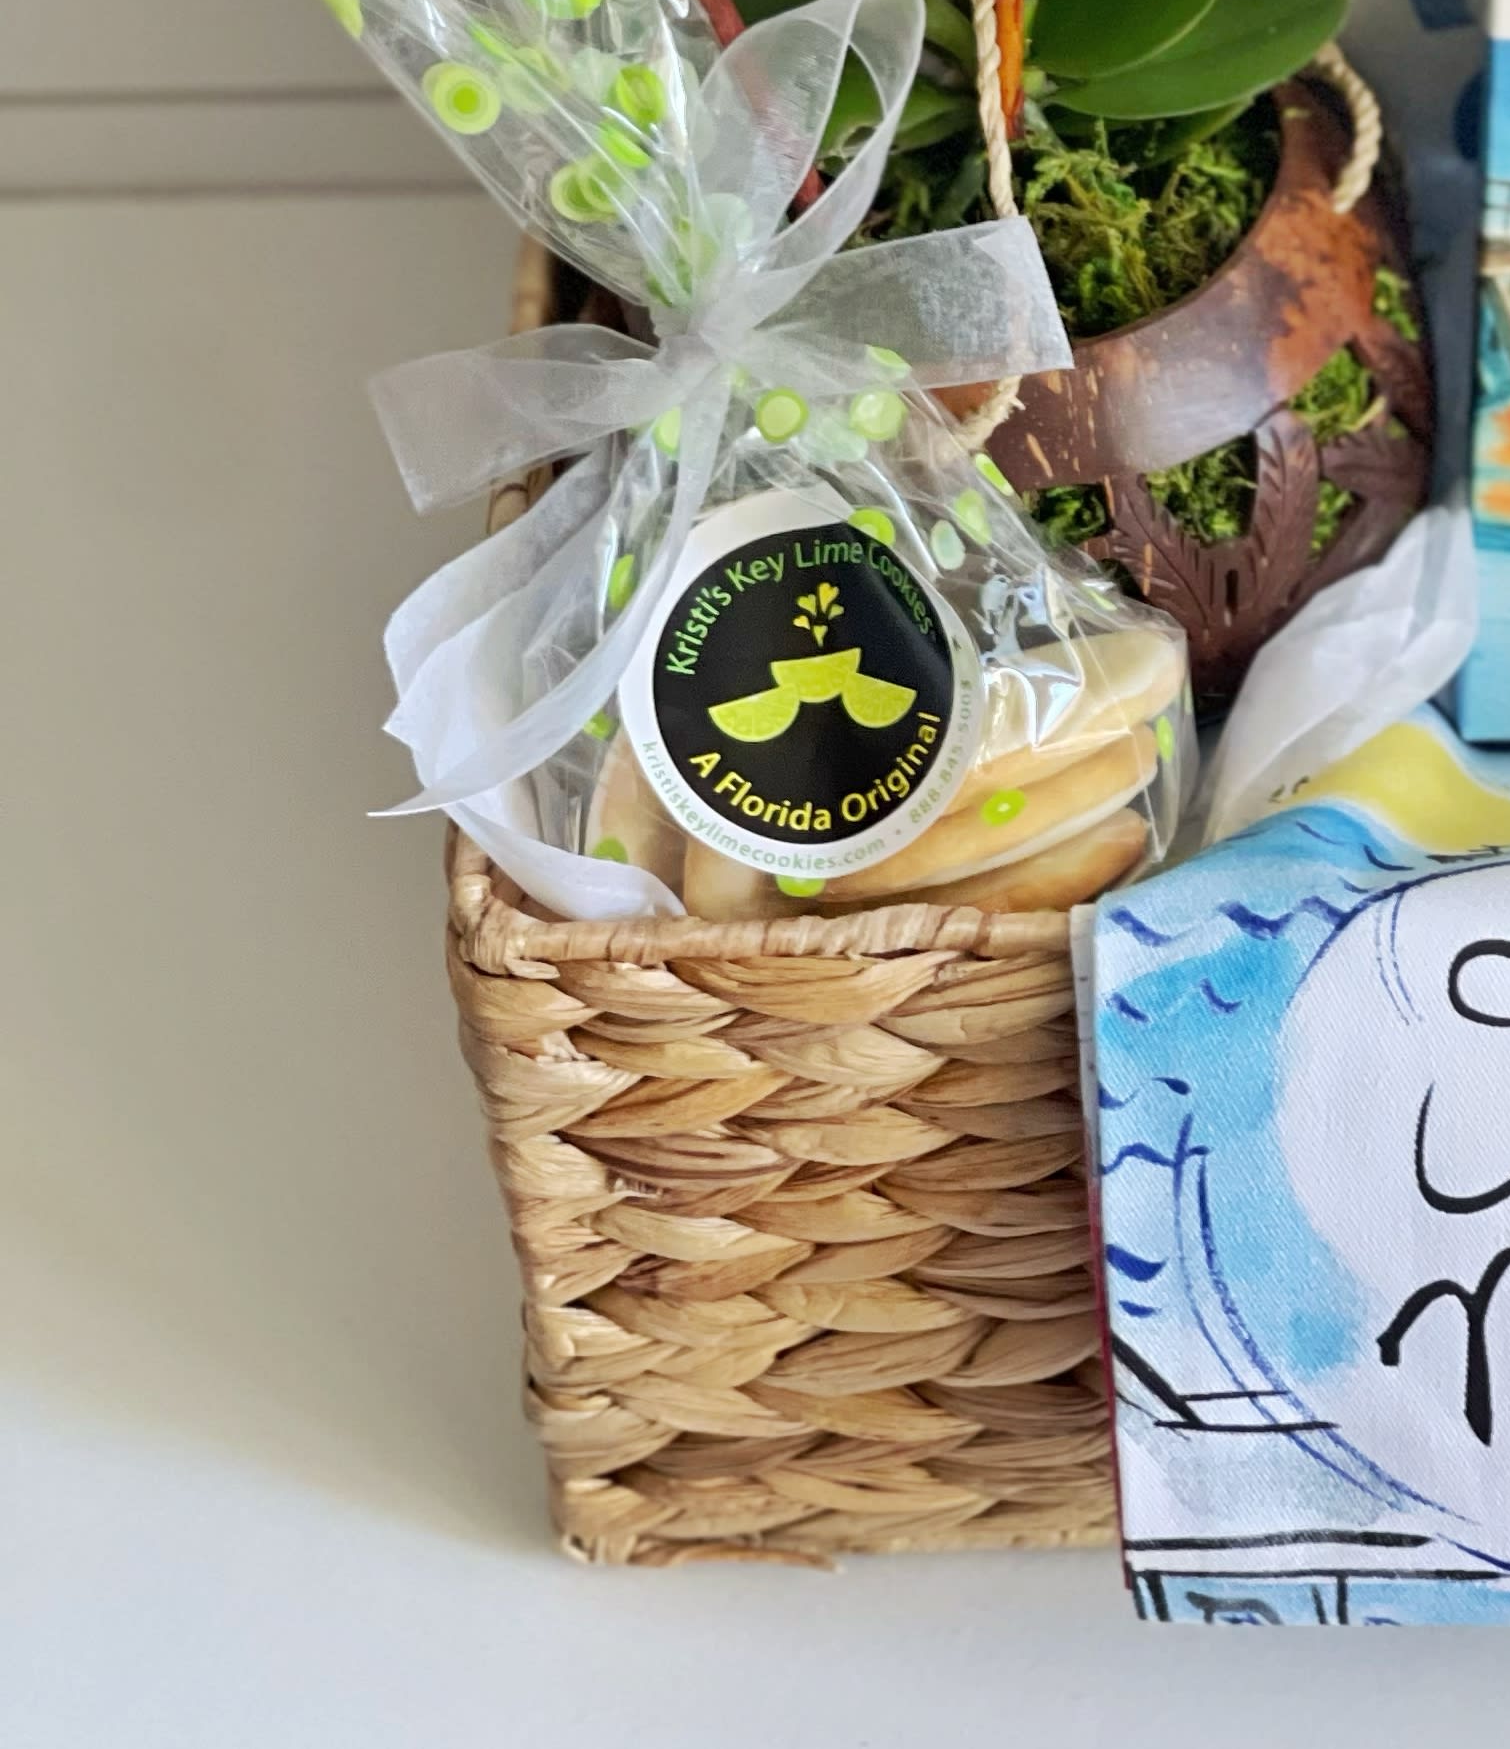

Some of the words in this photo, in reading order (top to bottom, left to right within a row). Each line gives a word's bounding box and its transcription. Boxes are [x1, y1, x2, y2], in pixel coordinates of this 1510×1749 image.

[665, 583, 733, 676] Kristi's
[725, 552, 786, 593] Key
[794, 538, 864, 568] Lime
[868, 539, 934, 635] Cookies
[640, 740, 886, 871] kristiskeylimecookies.com
[688, 751, 722, 779] A
[713, 770, 833, 832] Florida
[840, 711, 942, 823] Original
